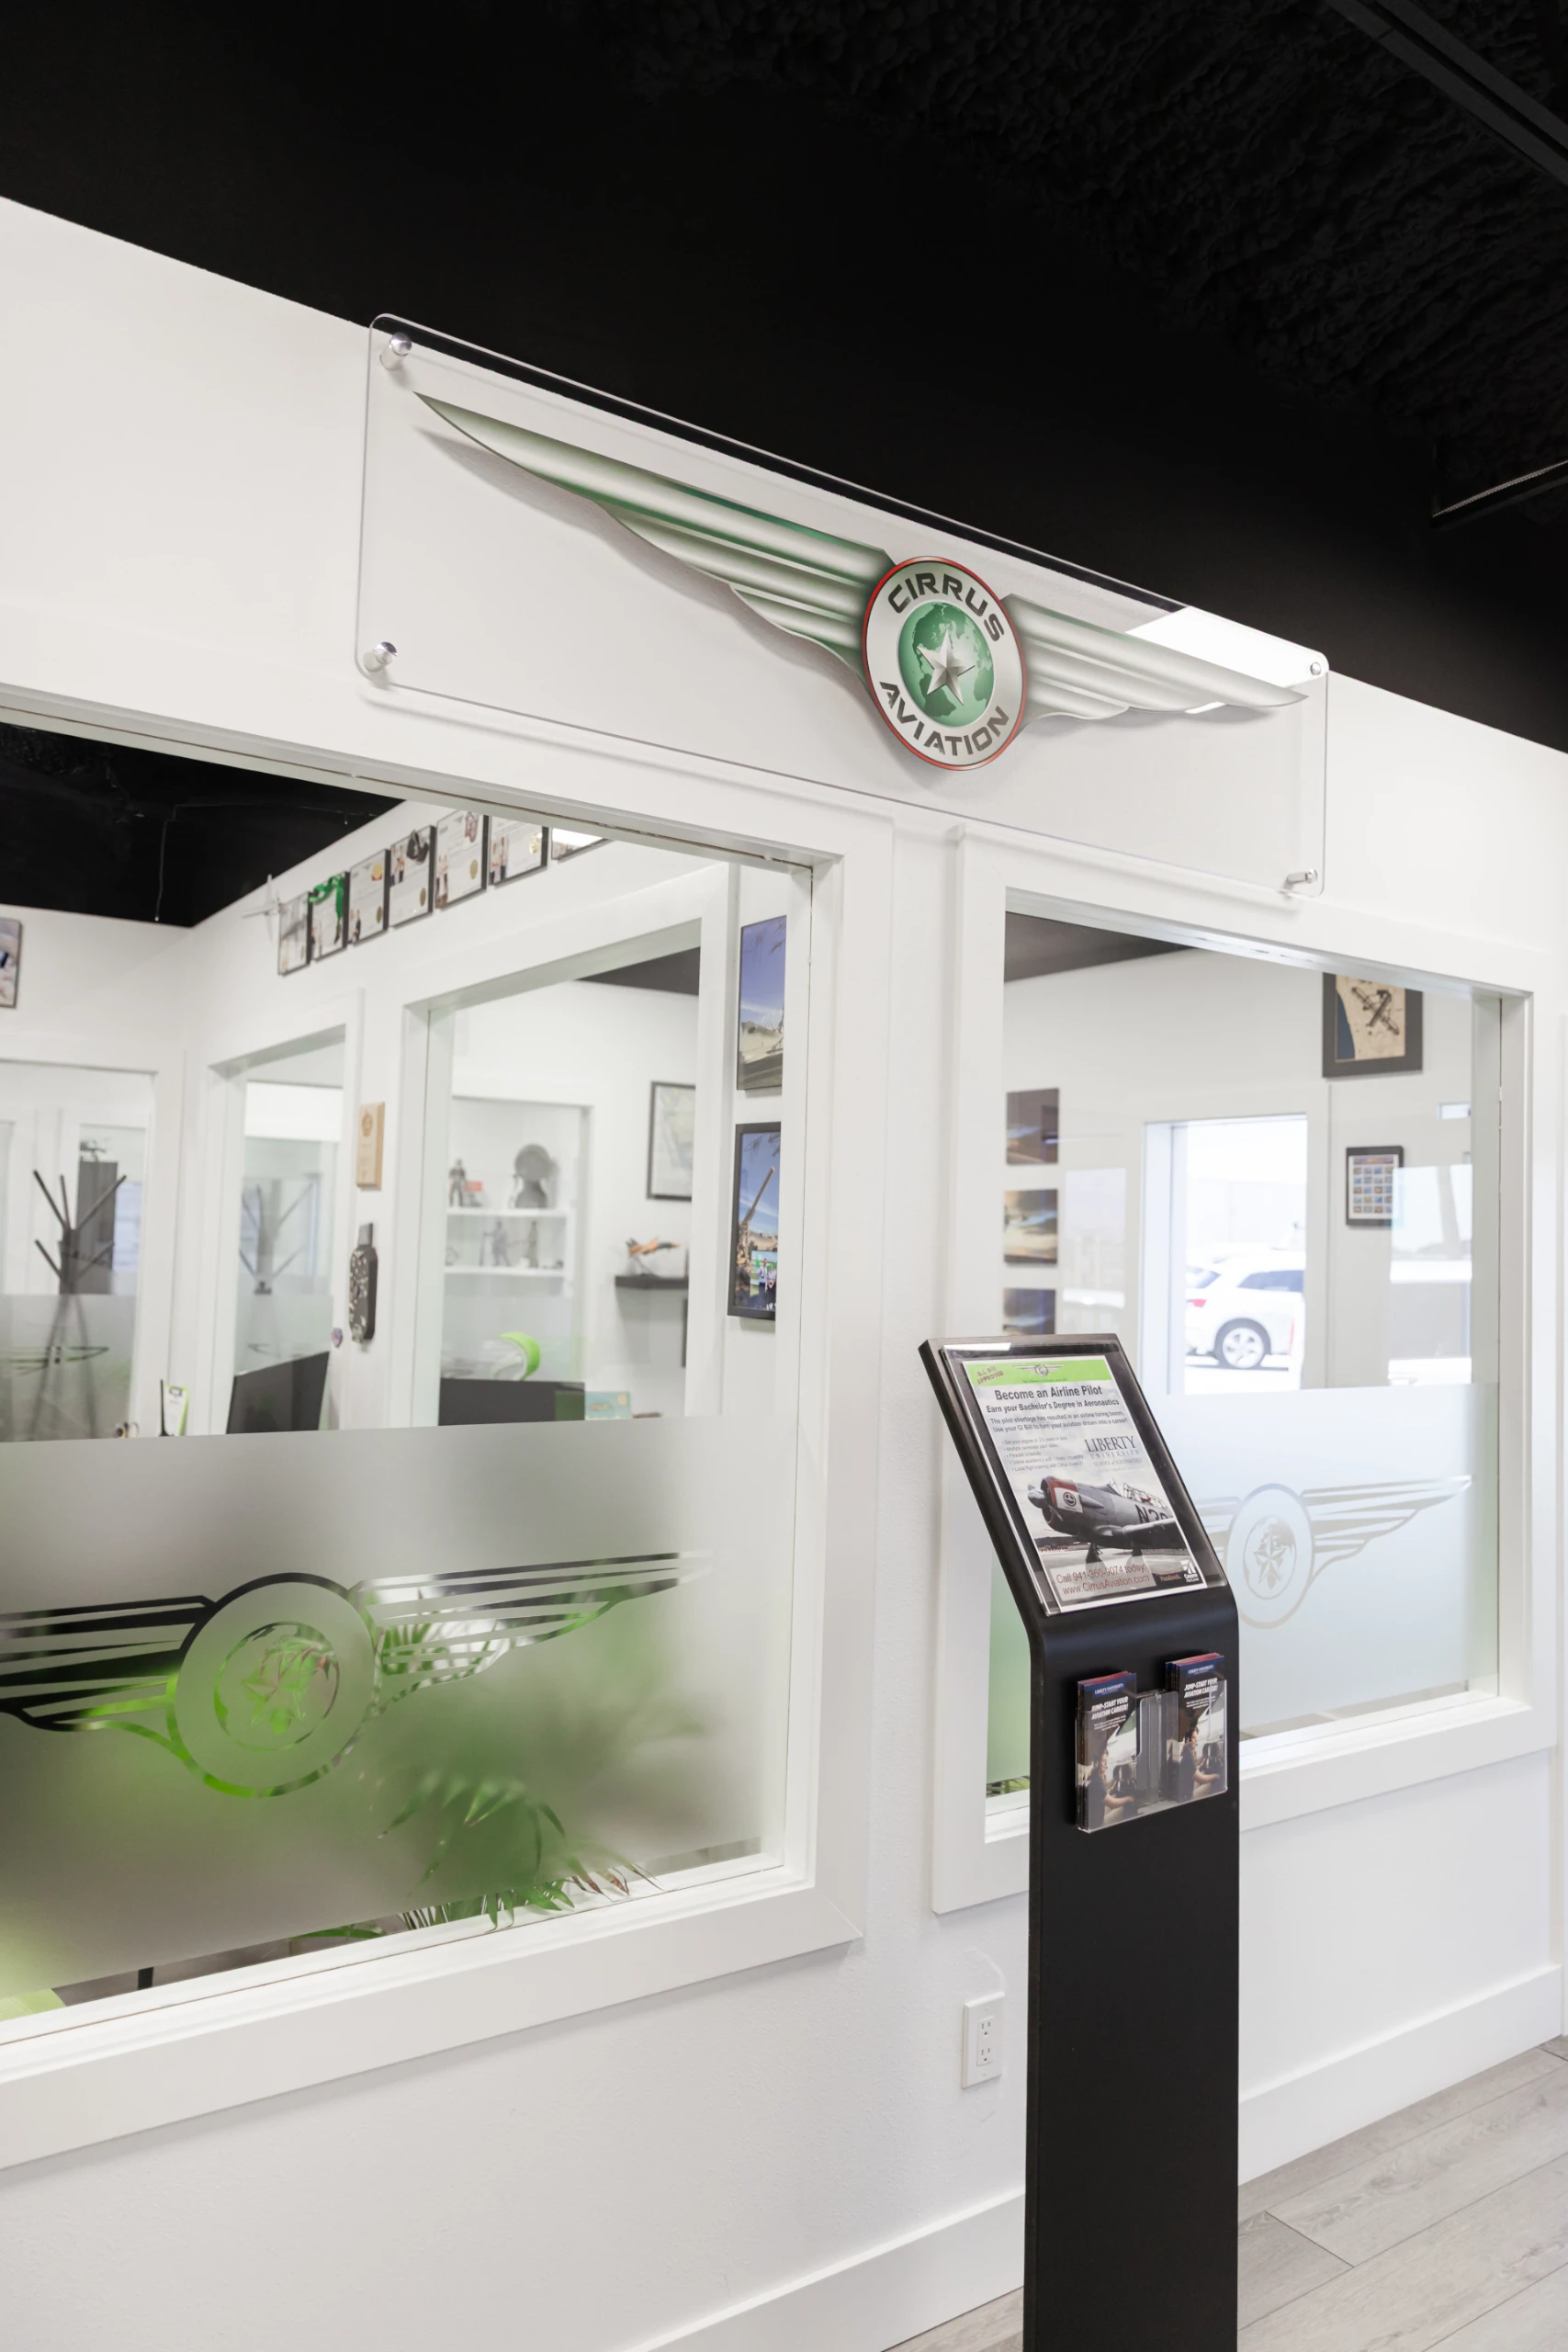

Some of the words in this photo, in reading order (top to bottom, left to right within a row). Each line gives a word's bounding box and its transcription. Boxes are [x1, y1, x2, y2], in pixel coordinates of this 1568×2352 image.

[887, 572, 1005, 642] CIRRUS
[879, 681, 1010, 757] AVIATION
[976, 1370, 1004, 1385] APPROVED
[994, 1389, 1034, 1400] Become
[1036, 1389, 1049, 1398] an
[1050, 1385, 1080, 1397] Airline
[1080, 1385, 1103, 1396] Pilot
[986, 1405, 1002, 1413] Earn
[1004, 1406, 1018, 1414] your
[1019, 1402, 1053, 1411] Bachelor's
[1053, 1401, 1076, 1410] Degree
[1084, 1398, 1120, 1408] Aeronautics
[1084, 1435, 1135, 1453] LIBERTY
[1089, 1450, 1139, 1460] UNIVERSITY
[1056, 1572, 1072, 1584] Call
[1073, 1566, 1122, 1581] 941-360-9074
[1062, 1575, 1150, 1595] www.CirrusAviation.com
[1184, 1679, 1208, 1691] JUMP-START
[1207, 1677, 1218, 1686] YOUR
[1183, 1688, 1202, 1699] AVIATION
[1091, 1699, 1117, 1713] JUMP-START
[1116, 1696, 1129, 1705] YOUR
[1091, 1708, 1111, 1720] AVIATION
[1111, 1703, 1129, 1715] CAREER!
